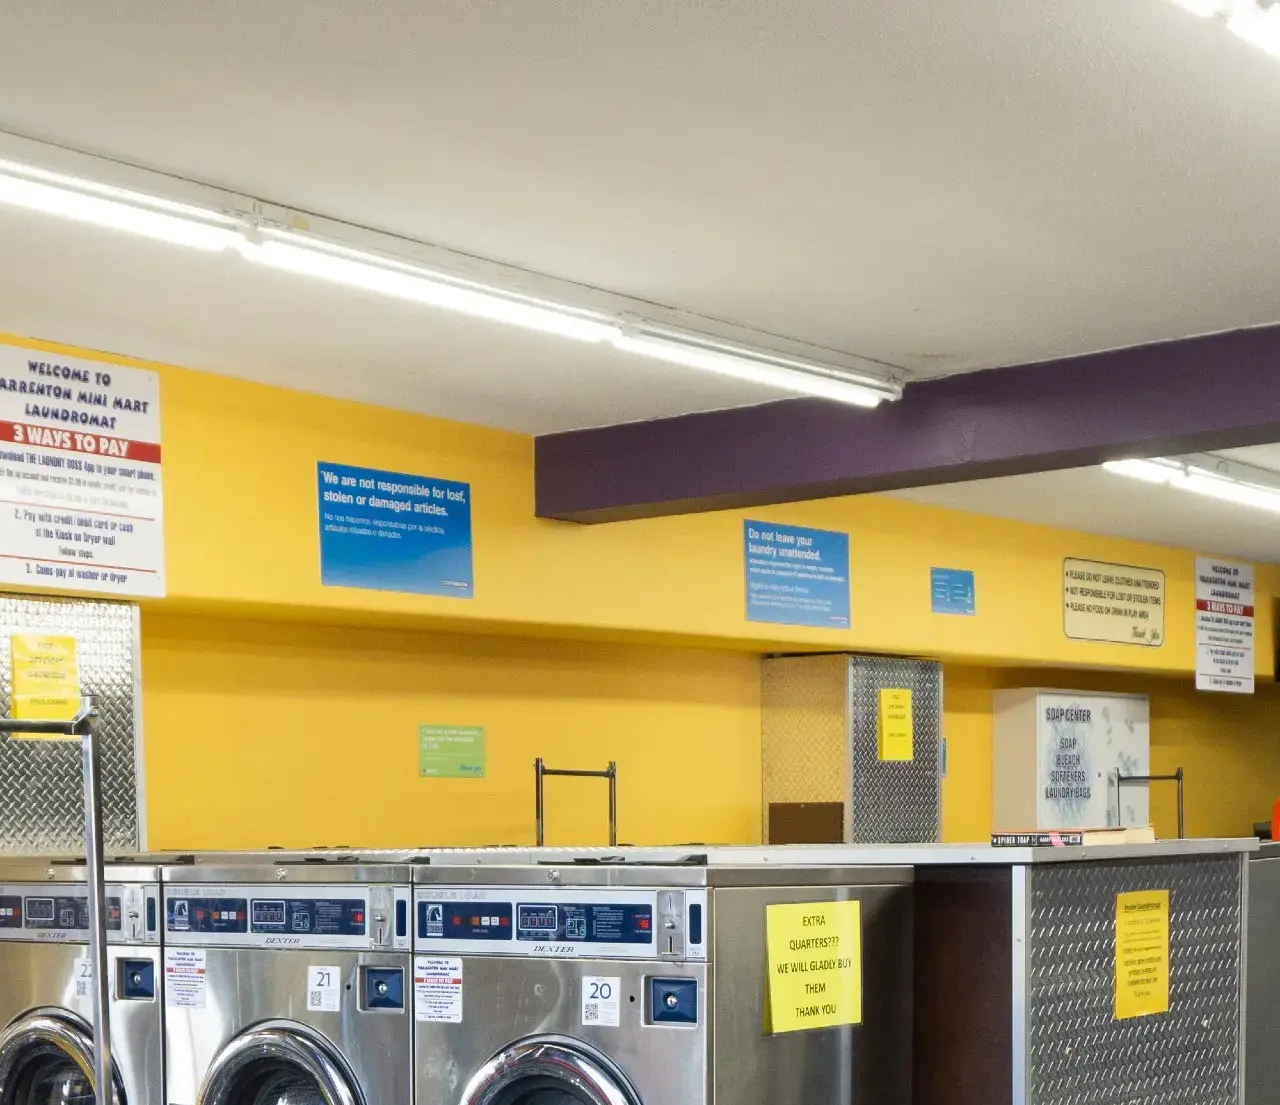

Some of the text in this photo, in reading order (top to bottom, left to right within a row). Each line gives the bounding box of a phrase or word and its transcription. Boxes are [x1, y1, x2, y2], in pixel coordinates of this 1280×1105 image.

[27, 360, 111, 388] WELCOME TO
[77, 390, 108, 407] MINI
[112, 396, 149, 414] MART
[24, 402, 117, 430] LAUNDROMAT
[13, 424, 128, 457] 3 WAYS TO PAY
[26, 452, 37, 465] THE
[38, 454, 66, 469] LAUNDRY
[67, 458, 82, 471] BOSS
[84, 460, 95, 474] App
[103, 465, 117, 476] your
[119, 468, 136, 479] smart
[322, 470, 339, 485] We
[341, 475, 357, 487] are
[359, 477, 375, 490] not
[377, 480, 430, 497] responsible
[432, 486, 445, 499] for
[323, 490, 448, 517] stolen or damaged articles.
[23, 509, 36, 523] Pay
[38, 511, 52, 523] with
[94, 519, 108, 530] card
[110, 522, 118, 531] or
[119, 522, 134, 533] cash
[42, 527, 53, 539] the
[55, 528, 73, 541] Kiosk
[74, 532, 82, 542] on
[83, 531, 101, 545] Dryer
[103, 535, 116, 546] wall
[748, 527, 813, 547] Do not leave your
[748, 541, 777, 557] laundry
[68, 568, 74, 578] at
[76, 568, 99, 580] washer
[100, 571, 108, 581] or
[110, 571, 128, 584] dryer
[1069, 569, 1160, 590] PLEASE DO NOT LEAVE CLOTHES UNATTENDED
[1069, 586, 1161, 606] NOT RESPONSIBLE FOR LOST OR STOLEN ITEMS
[1070, 601, 1086, 612] PLEASE
[1086, 604, 1093, 613] NO
[1093, 604, 1104, 615] FOOD
[1104, 606, 1111, 615] OR
[1111, 607, 1123, 617] DRINK
[1128, 609, 1138, 618] PLAY
[1138, 610, 1149, 619] AREA
[1226, 603, 1233, 614] TO
[1046, 707, 1092, 722] SOAP CENTER
[1060, 737, 1077, 750] SOAP
[1056, 753, 1080, 765] BLEACH
[1051, 770, 1086, 782] SOFTENERS
[1045, 786, 1091, 799] LAUNDRY BAGS
[1017, 836, 1030, 844] TRAP
[802, 915, 826, 927] EXTRA
[264, 937, 300, 945] DEXTER
[533, 945, 575, 953] DEXTER
[789, 936, 840, 951] QUARTERS???
[776, 957, 852, 974] WE WILL GLADLY BUY
[316, 971, 331, 988] 21
[589, 982, 612, 1000] 20
[804, 983, 826, 995] THEM
[795, 1004, 837, 1018] THANK YOU
